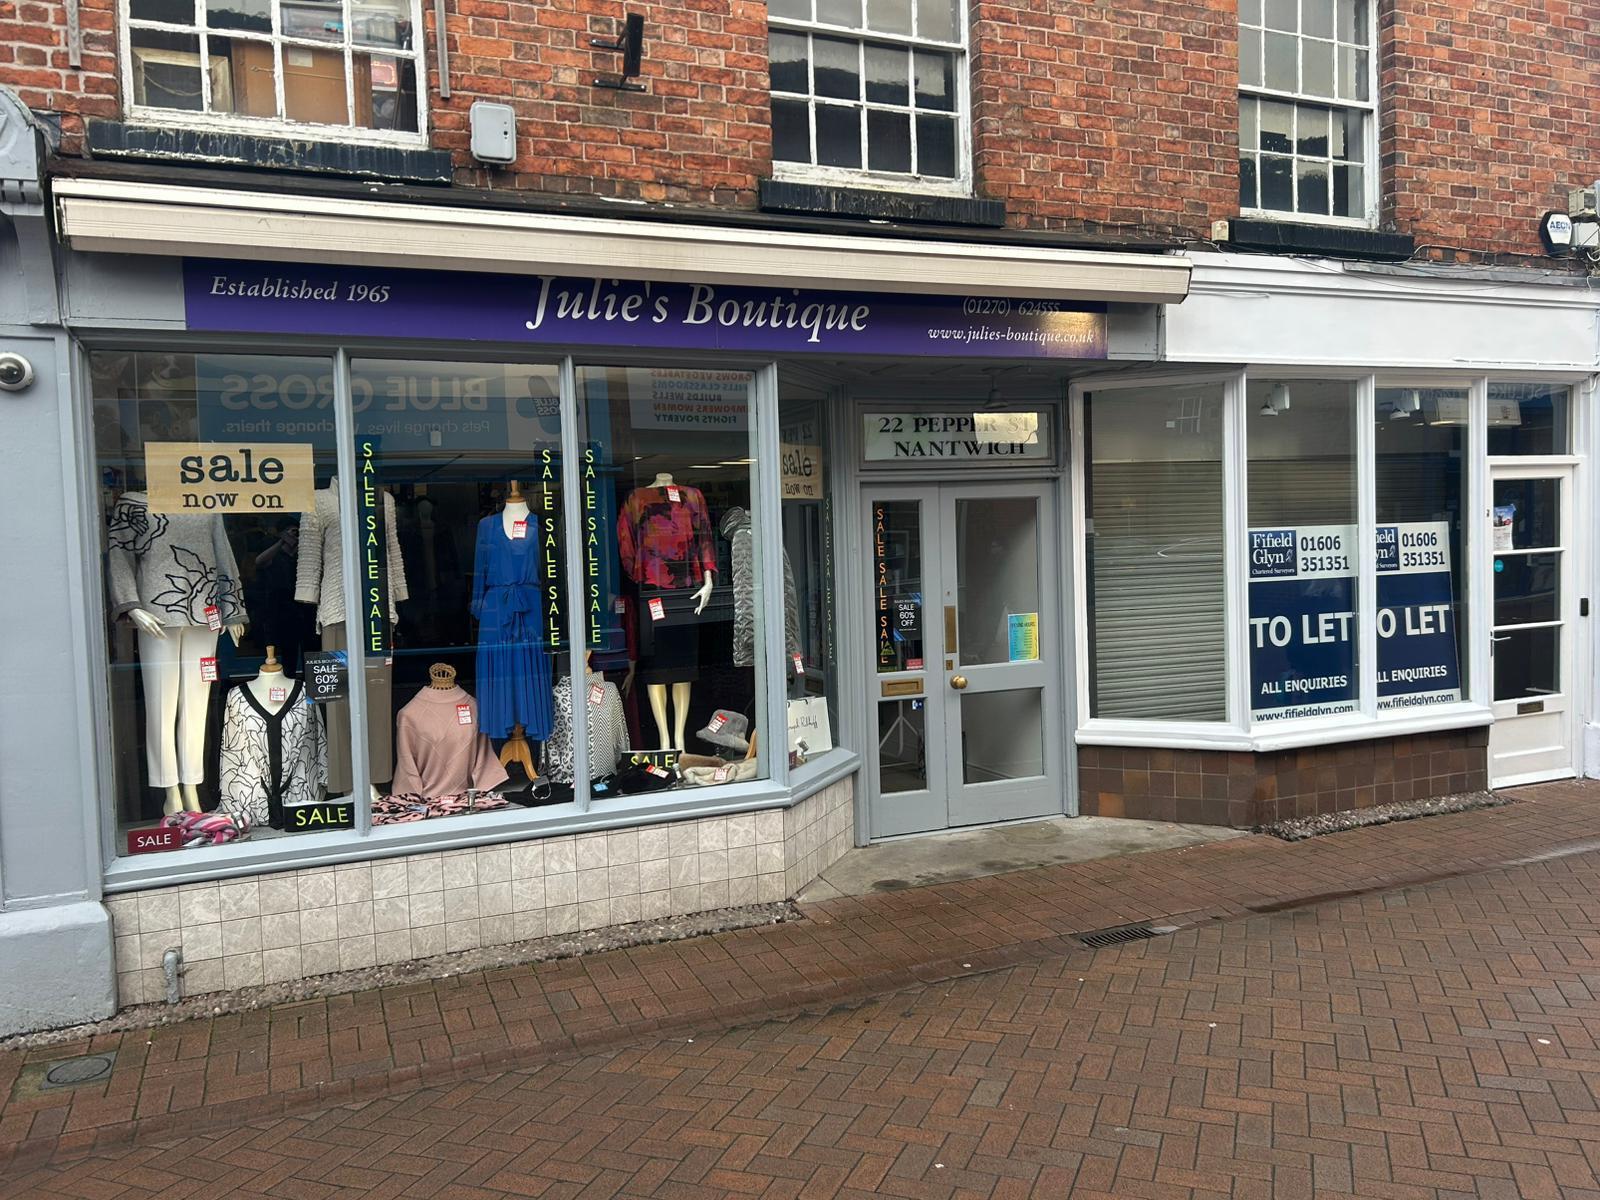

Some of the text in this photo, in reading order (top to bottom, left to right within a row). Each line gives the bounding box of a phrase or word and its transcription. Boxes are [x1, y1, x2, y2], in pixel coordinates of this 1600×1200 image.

[209, 275, 391, 303] Established 1965
[525, 275, 870, 342] Julie's Boutique
[962, 296, 1061, 317] (01270) 624555
[927, 325, 1095, 346] www.julies-boutique.co.uk
[879, 416, 903, 433] 22
[913, 416, 996, 434] PEPPER
[894, 440, 1026, 458] NANTWICH
[180, 448, 284, 485] sale
[782, 449, 812, 477] sale
[784, 483, 801, 497] now
[182, 492, 284, 510] now on
[876, 508, 885, 557] SALE
[1252, 531, 1293, 549] Fifield
[1376, 529, 1396, 544] ield
[1402, 531, 1437, 547] 01606
[362, 442, 383, 652] SALE SALE SALE
[541, 449, 561, 646] SALE SALE SALE
[584, 449, 602, 644] SALE SALE SALE
[1300, 535, 1341, 551] 01606
[1252, 549, 1285, 568] Glyn
[1376, 548, 1388, 560] yn
[1403, 551, 1445, 567] 351351
[1301, 556, 1350, 572] 351351
[879, 562, 888, 611] SALE
[900, 619, 914, 627] OFF
[1249, 611, 1354, 648] TO LET
[1376, 604, 1450, 639] O LET
[313, 664, 338, 674] SALE
[1391, 665, 1448, 682] ENQUIRIES
[315, 674, 339, 685] 60%
[1260, 675, 1348, 695] ALL ENQUIRIES
[317, 684, 337, 694] OFF
[627, 753, 675, 770] SALE
[295, 806, 349, 827] SALE
[136, 833, 172, 848] SALE
